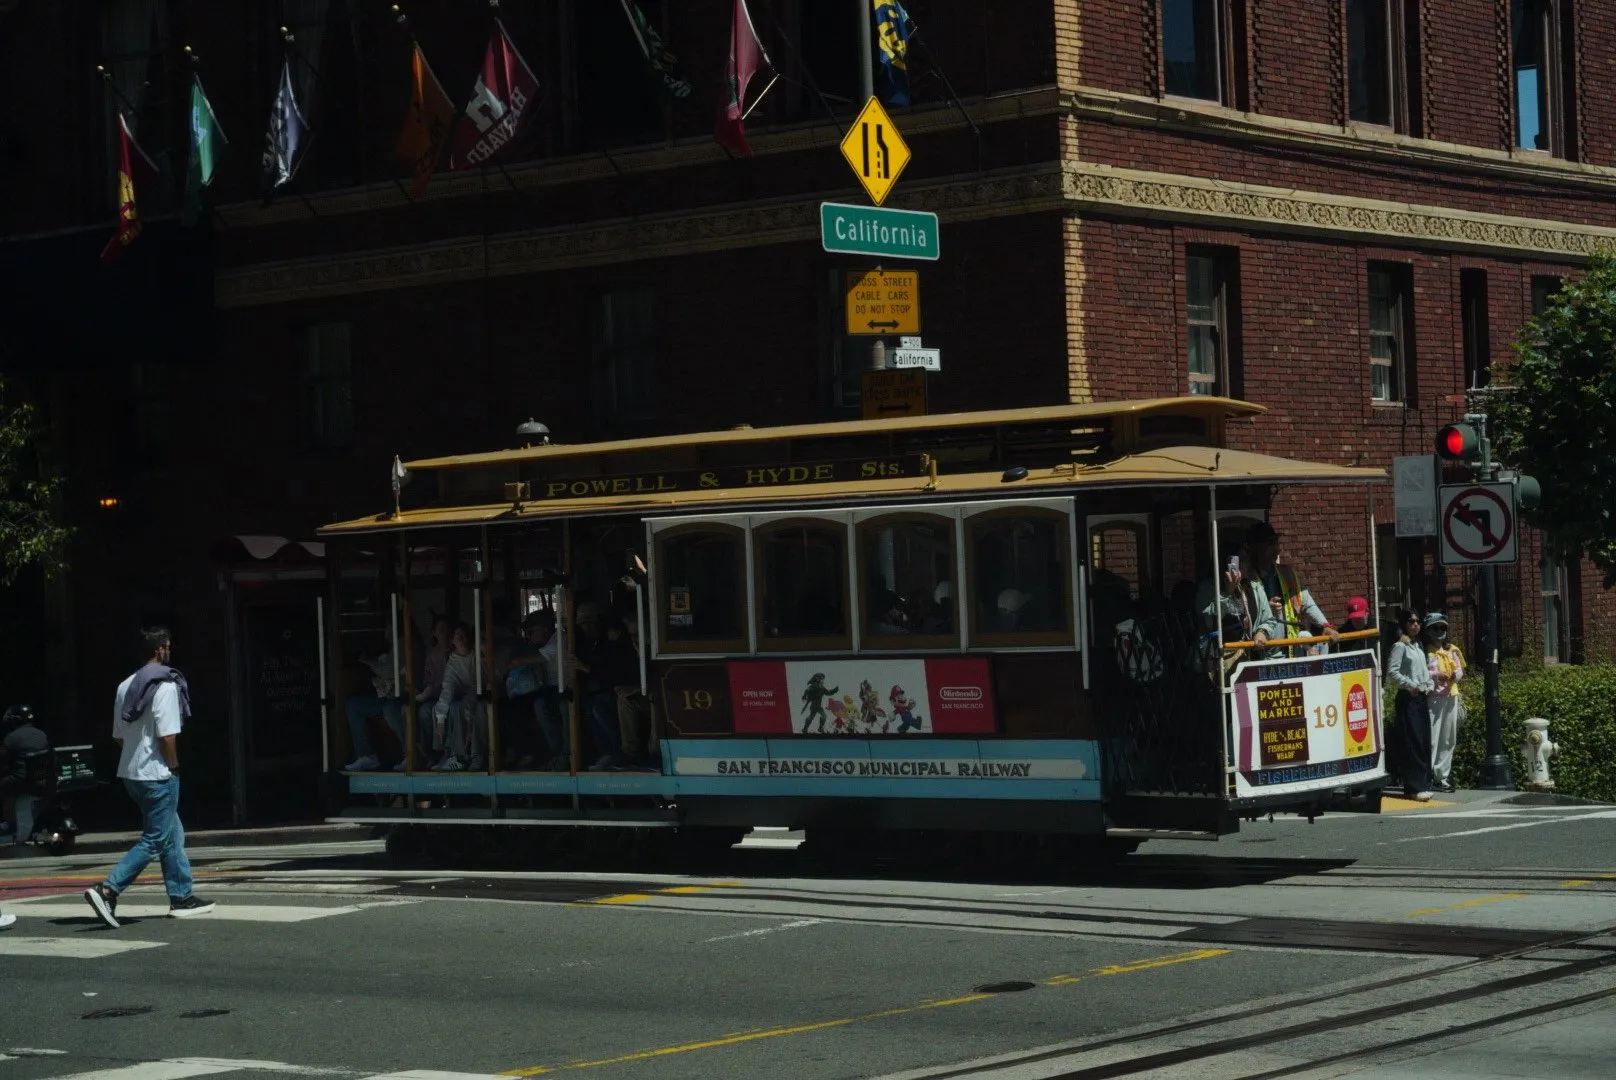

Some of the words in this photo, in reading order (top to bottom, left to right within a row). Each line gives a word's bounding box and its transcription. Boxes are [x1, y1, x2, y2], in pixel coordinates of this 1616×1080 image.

[835, 216, 927, 247] California
[883, 278, 913, 287] STREET
[855, 291, 881, 300] CABLE
[887, 291, 909, 300] CARS
[855, 304, 866, 314] DO
[870, 304, 886, 314] NOT
[890, 304, 911, 314] STOP
[892, 352, 933, 365] California
[546, 476, 677, 497] POWELL
[699, 472, 720, 488] &
[745, 464, 834, 484] HYDE
[861, 460, 905, 477] Sts.
[943, 689, 979, 697] Nintendo
[1260, 687, 1302, 701] POWELL
[683, 690, 713, 710] 19
[1272, 698, 1293, 707] AND
[1352, 701, 1364, 710] PASS
[1260, 705, 1304, 719] MARKET
[1313, 704, 1338, 728] 19
[1263, 731, 1279, 743] HYDE
[1286, 728, 1306, 740] BEACH
[1267, 742, 1304, 753] FISHERMANS
[1276, 751, 1296, 760] WHARF
[717, 760, 751, 774] SAN
[758, 760, 855, 774] FRANCISCO
[858, 761, 951, 776] MUNICIPAL
[957, 762, 1031, 776] RAILWAY
